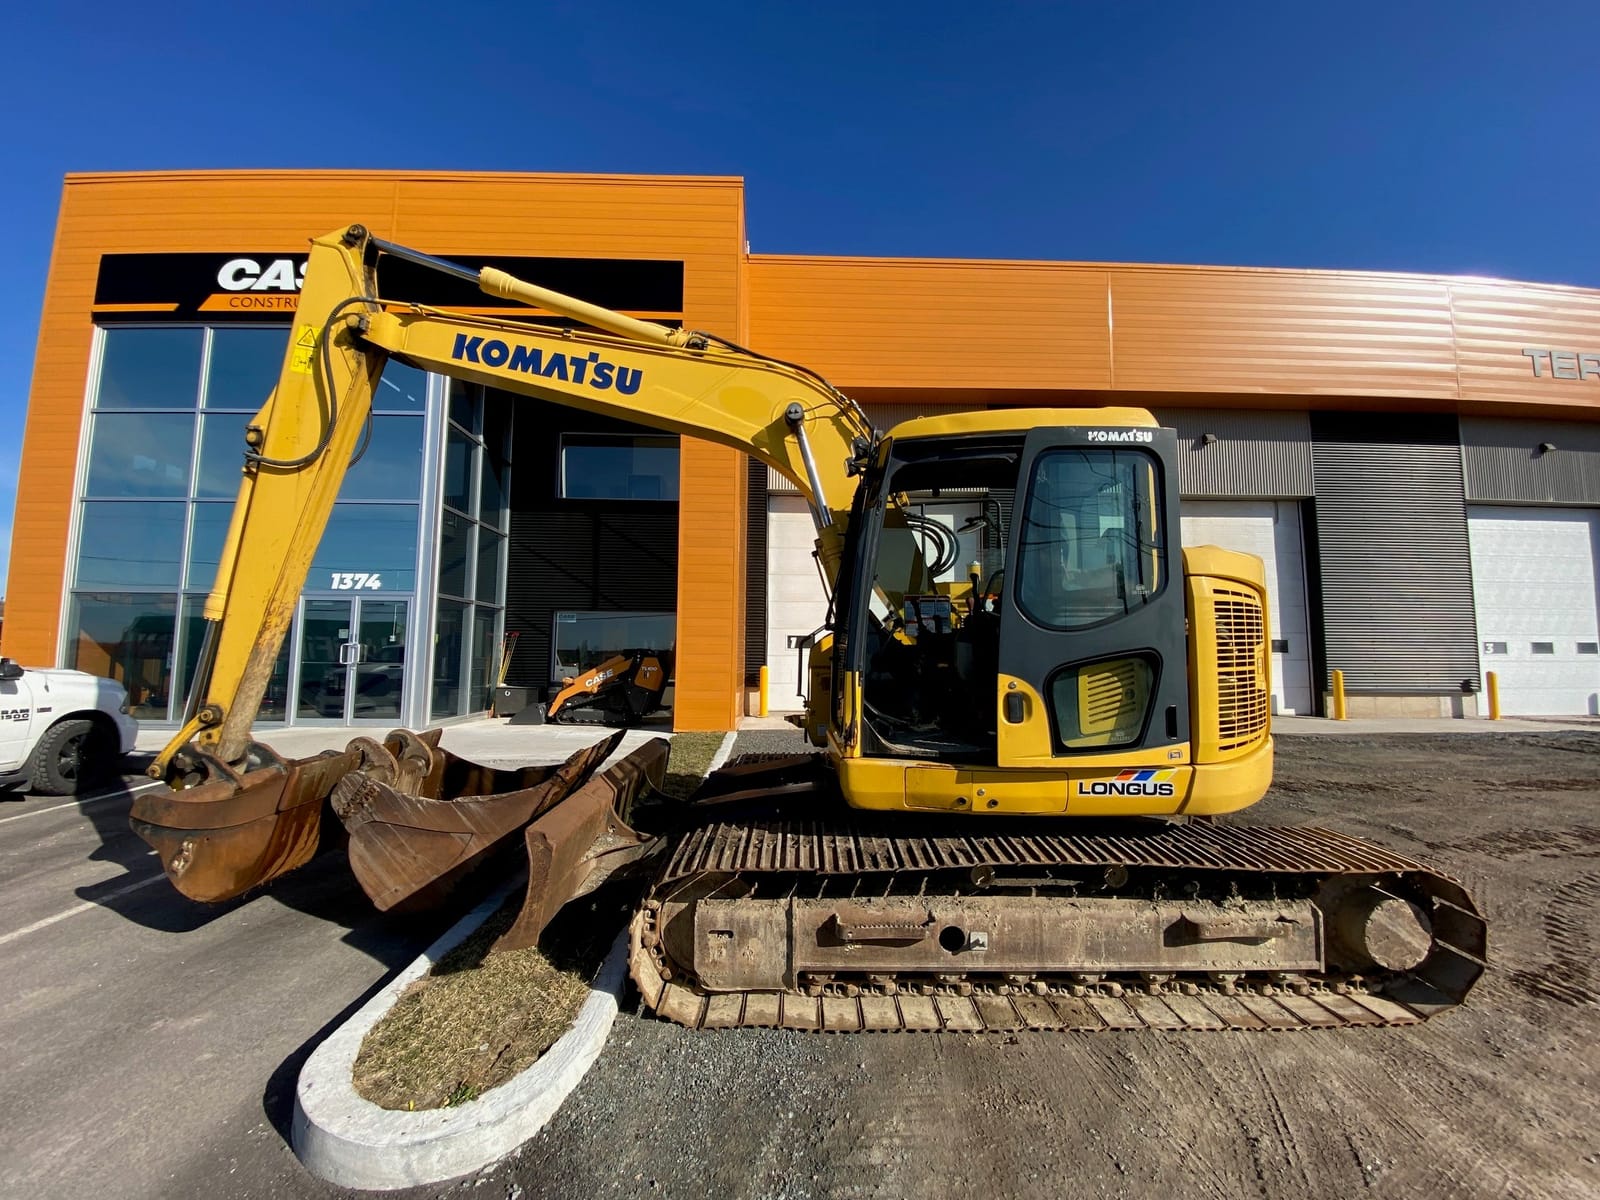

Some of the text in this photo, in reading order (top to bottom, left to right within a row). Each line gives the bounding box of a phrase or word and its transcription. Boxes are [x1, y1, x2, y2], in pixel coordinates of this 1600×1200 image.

[451, 333, 643, 395] KOMATSU
[1522, 348, 1600, 381] TER
[1088, 429, 1153, 442] KOMATSU
[331, 573, 382, 590] 1374
[1485, 643, 1494, 654] 3
[585, 669, 614, 687] CASE
[1079, 782, 1173, 796] LONGUS
